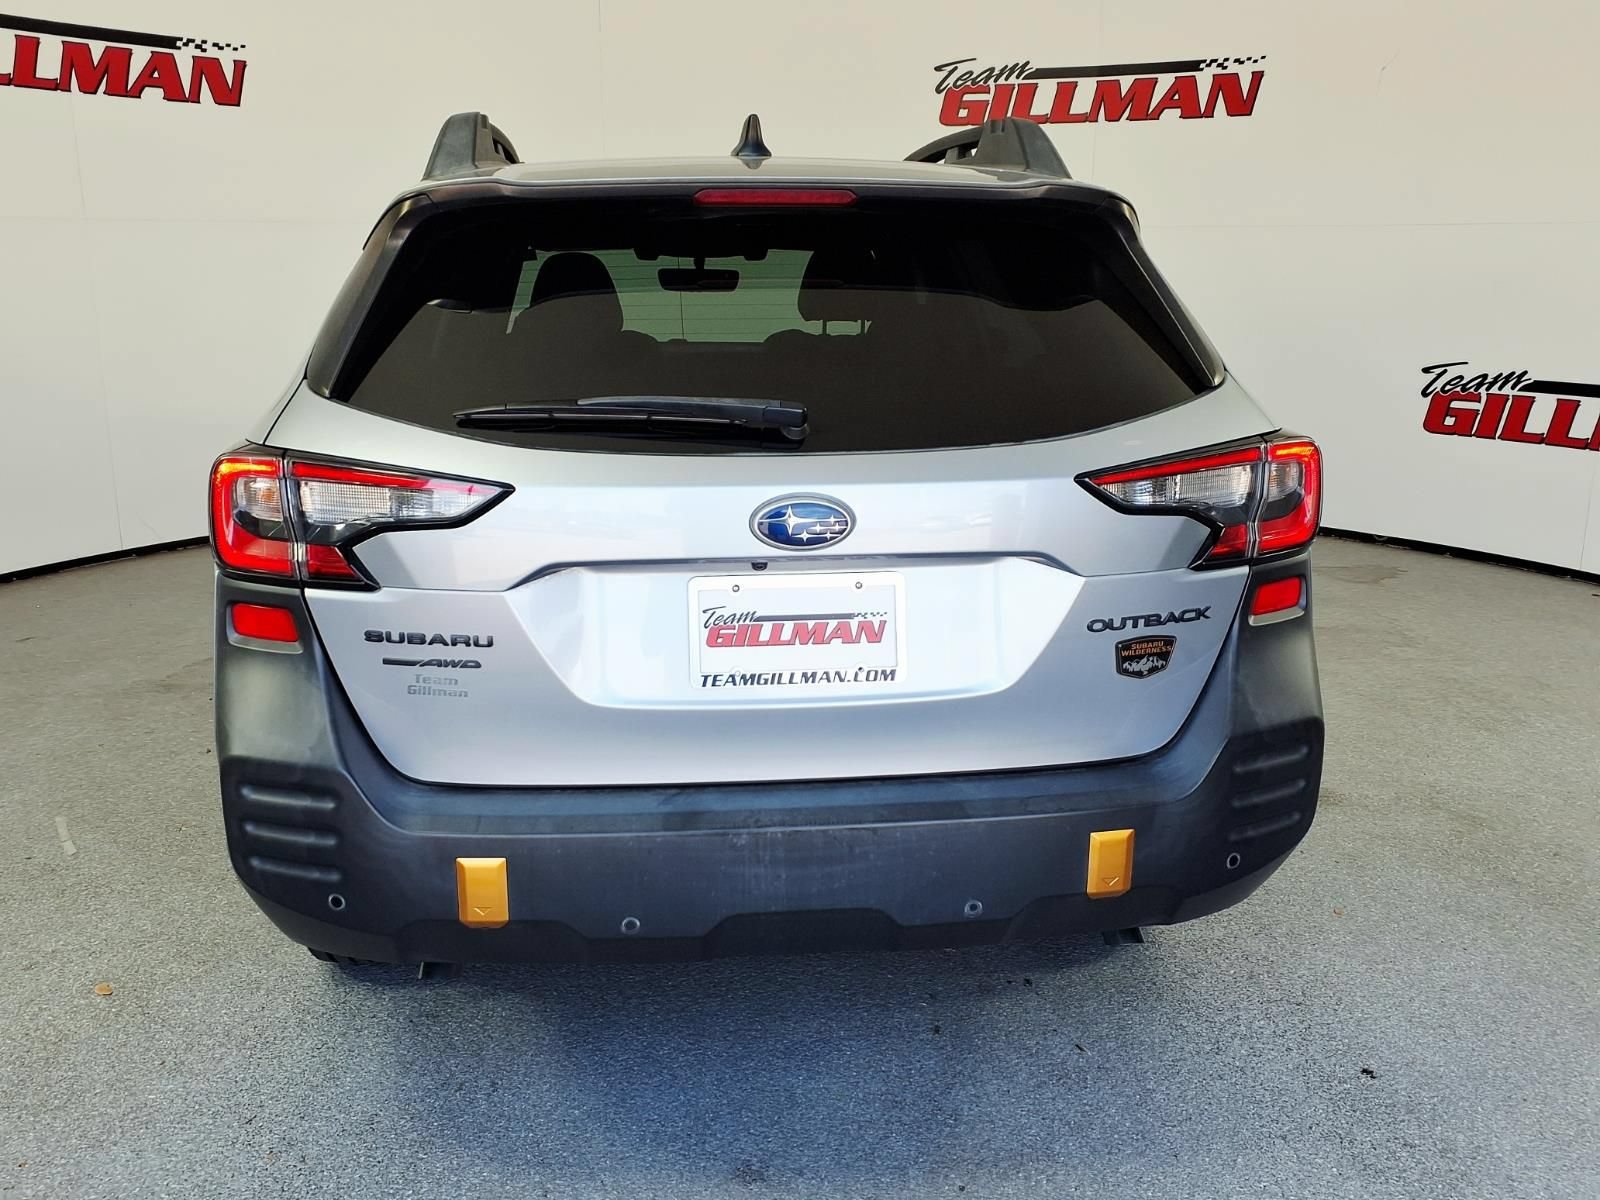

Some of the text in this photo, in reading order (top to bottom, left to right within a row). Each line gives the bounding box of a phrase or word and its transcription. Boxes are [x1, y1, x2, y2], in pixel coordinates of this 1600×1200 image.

[0, 34, 247, 107] LMAN
[933, 57, 1034, 94] Team
[939, 70, 1264, 126] GILLMAN
[1421, 361, 1532, 398] Team
[1423, 390, 1600, 452] GILL
[702, 606, 757, 629] Team
[1086, 606, 1212, 633] OUTBACK
[364, 629, 494, 648] SUBARU
[706, 620, 887, 648] GILLMAN
[1131, 641, 1164, 650] SUBARU
[1121, 646, 1172, 657] WILDERNESS
[419, 658, 482, 669] AWD
[415, 674, 458, 686] Team
[701, 669, 897, 688] TEAMGILLMAN.COM
[407, 685, 469, 698] Gillman
